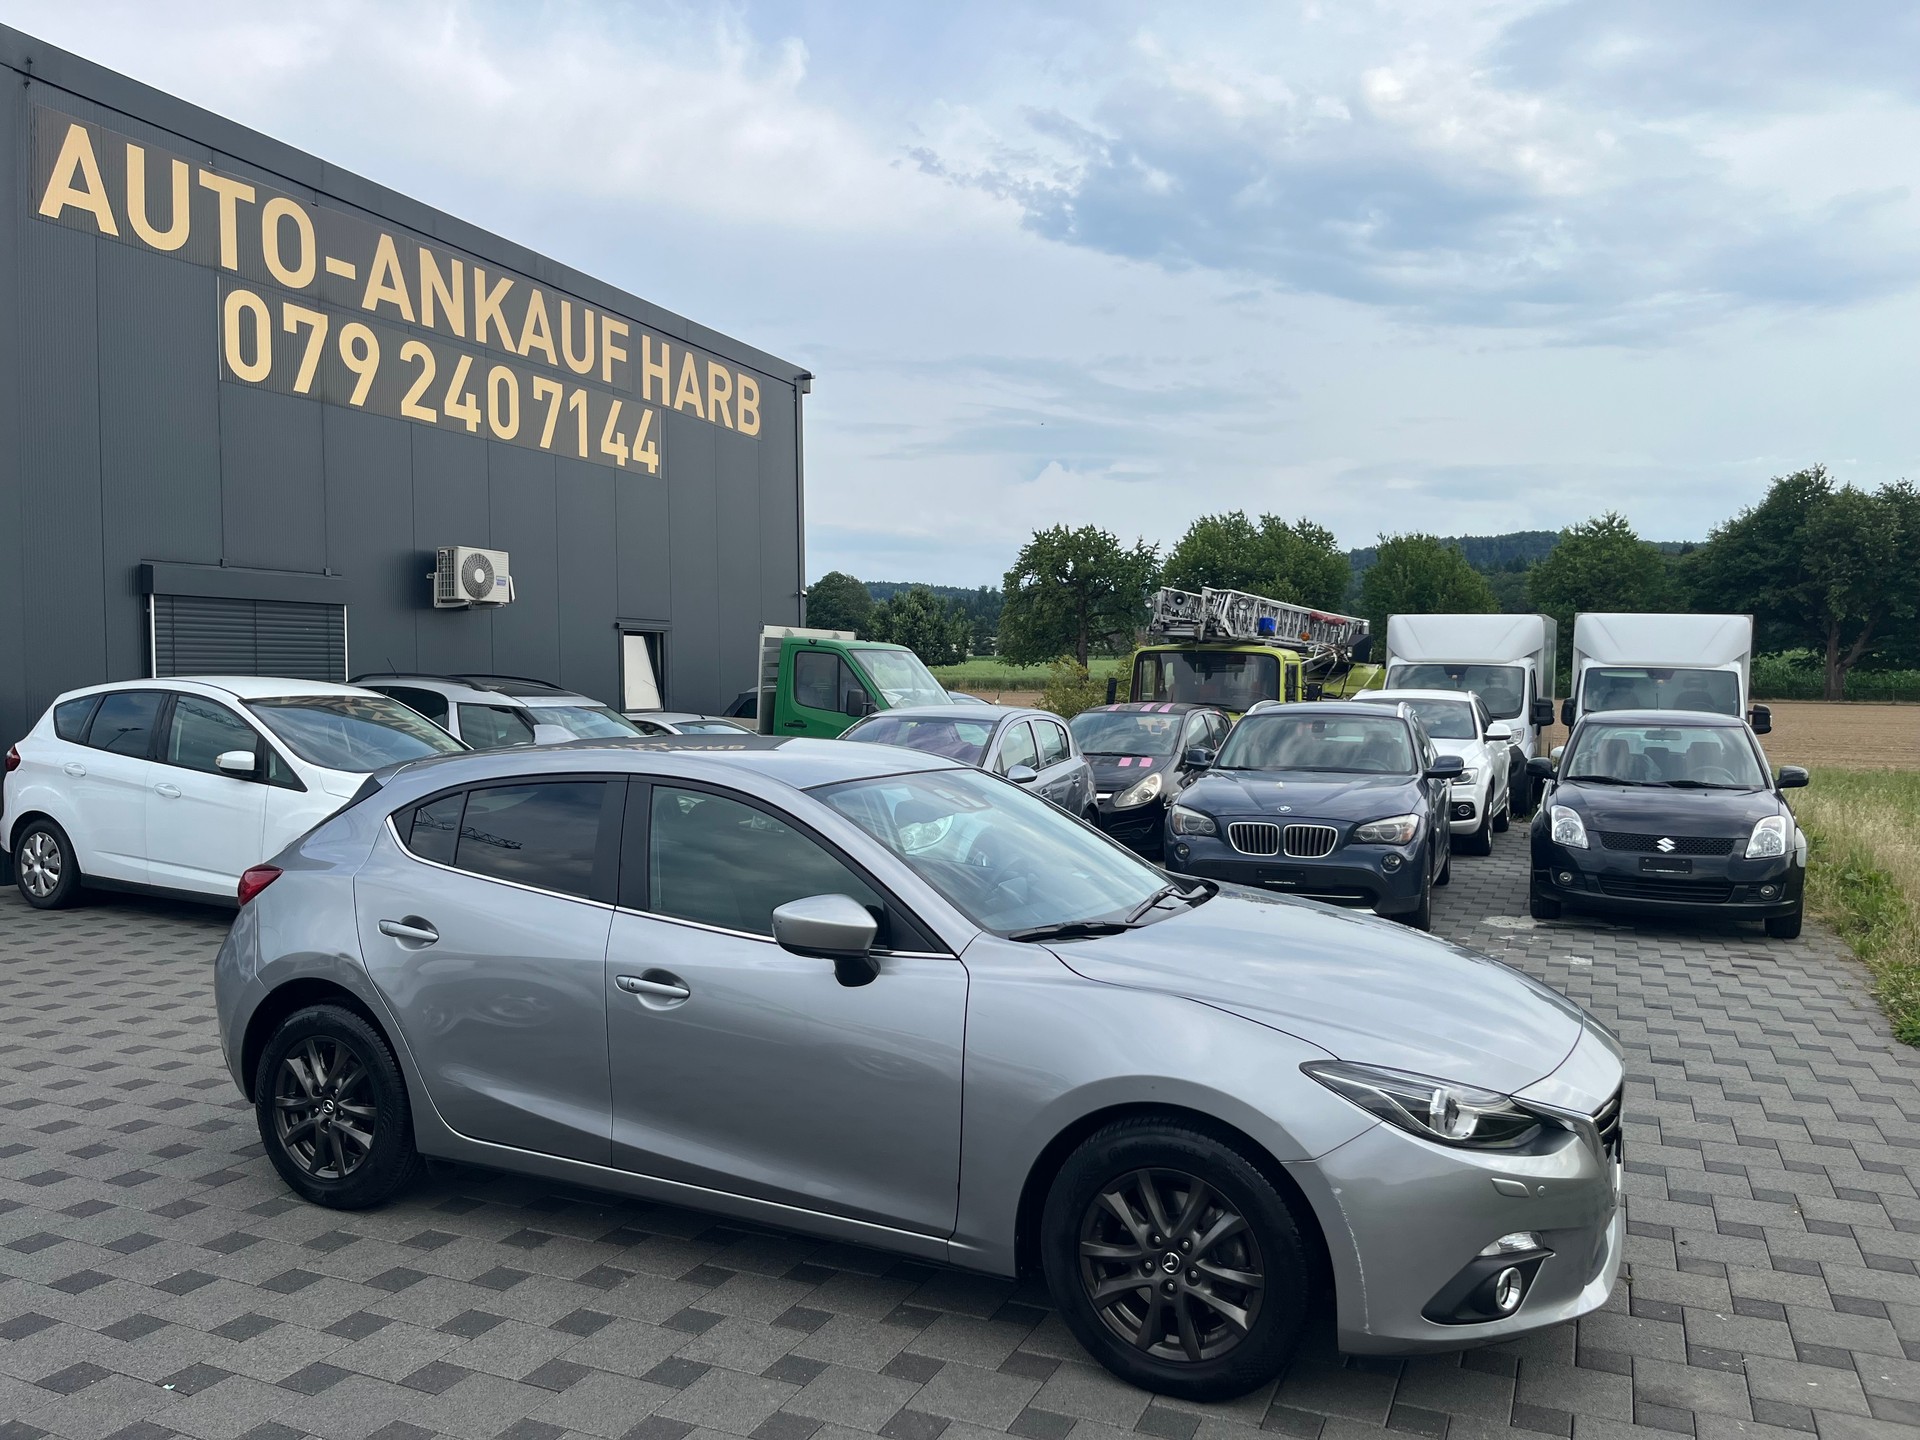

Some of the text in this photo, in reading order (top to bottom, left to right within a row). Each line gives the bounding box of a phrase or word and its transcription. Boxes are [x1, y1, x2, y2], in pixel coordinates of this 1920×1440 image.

[38, 123, 762, 437] AUTO-ANKAUF HARB
[224, 289, 381, 407] 079
